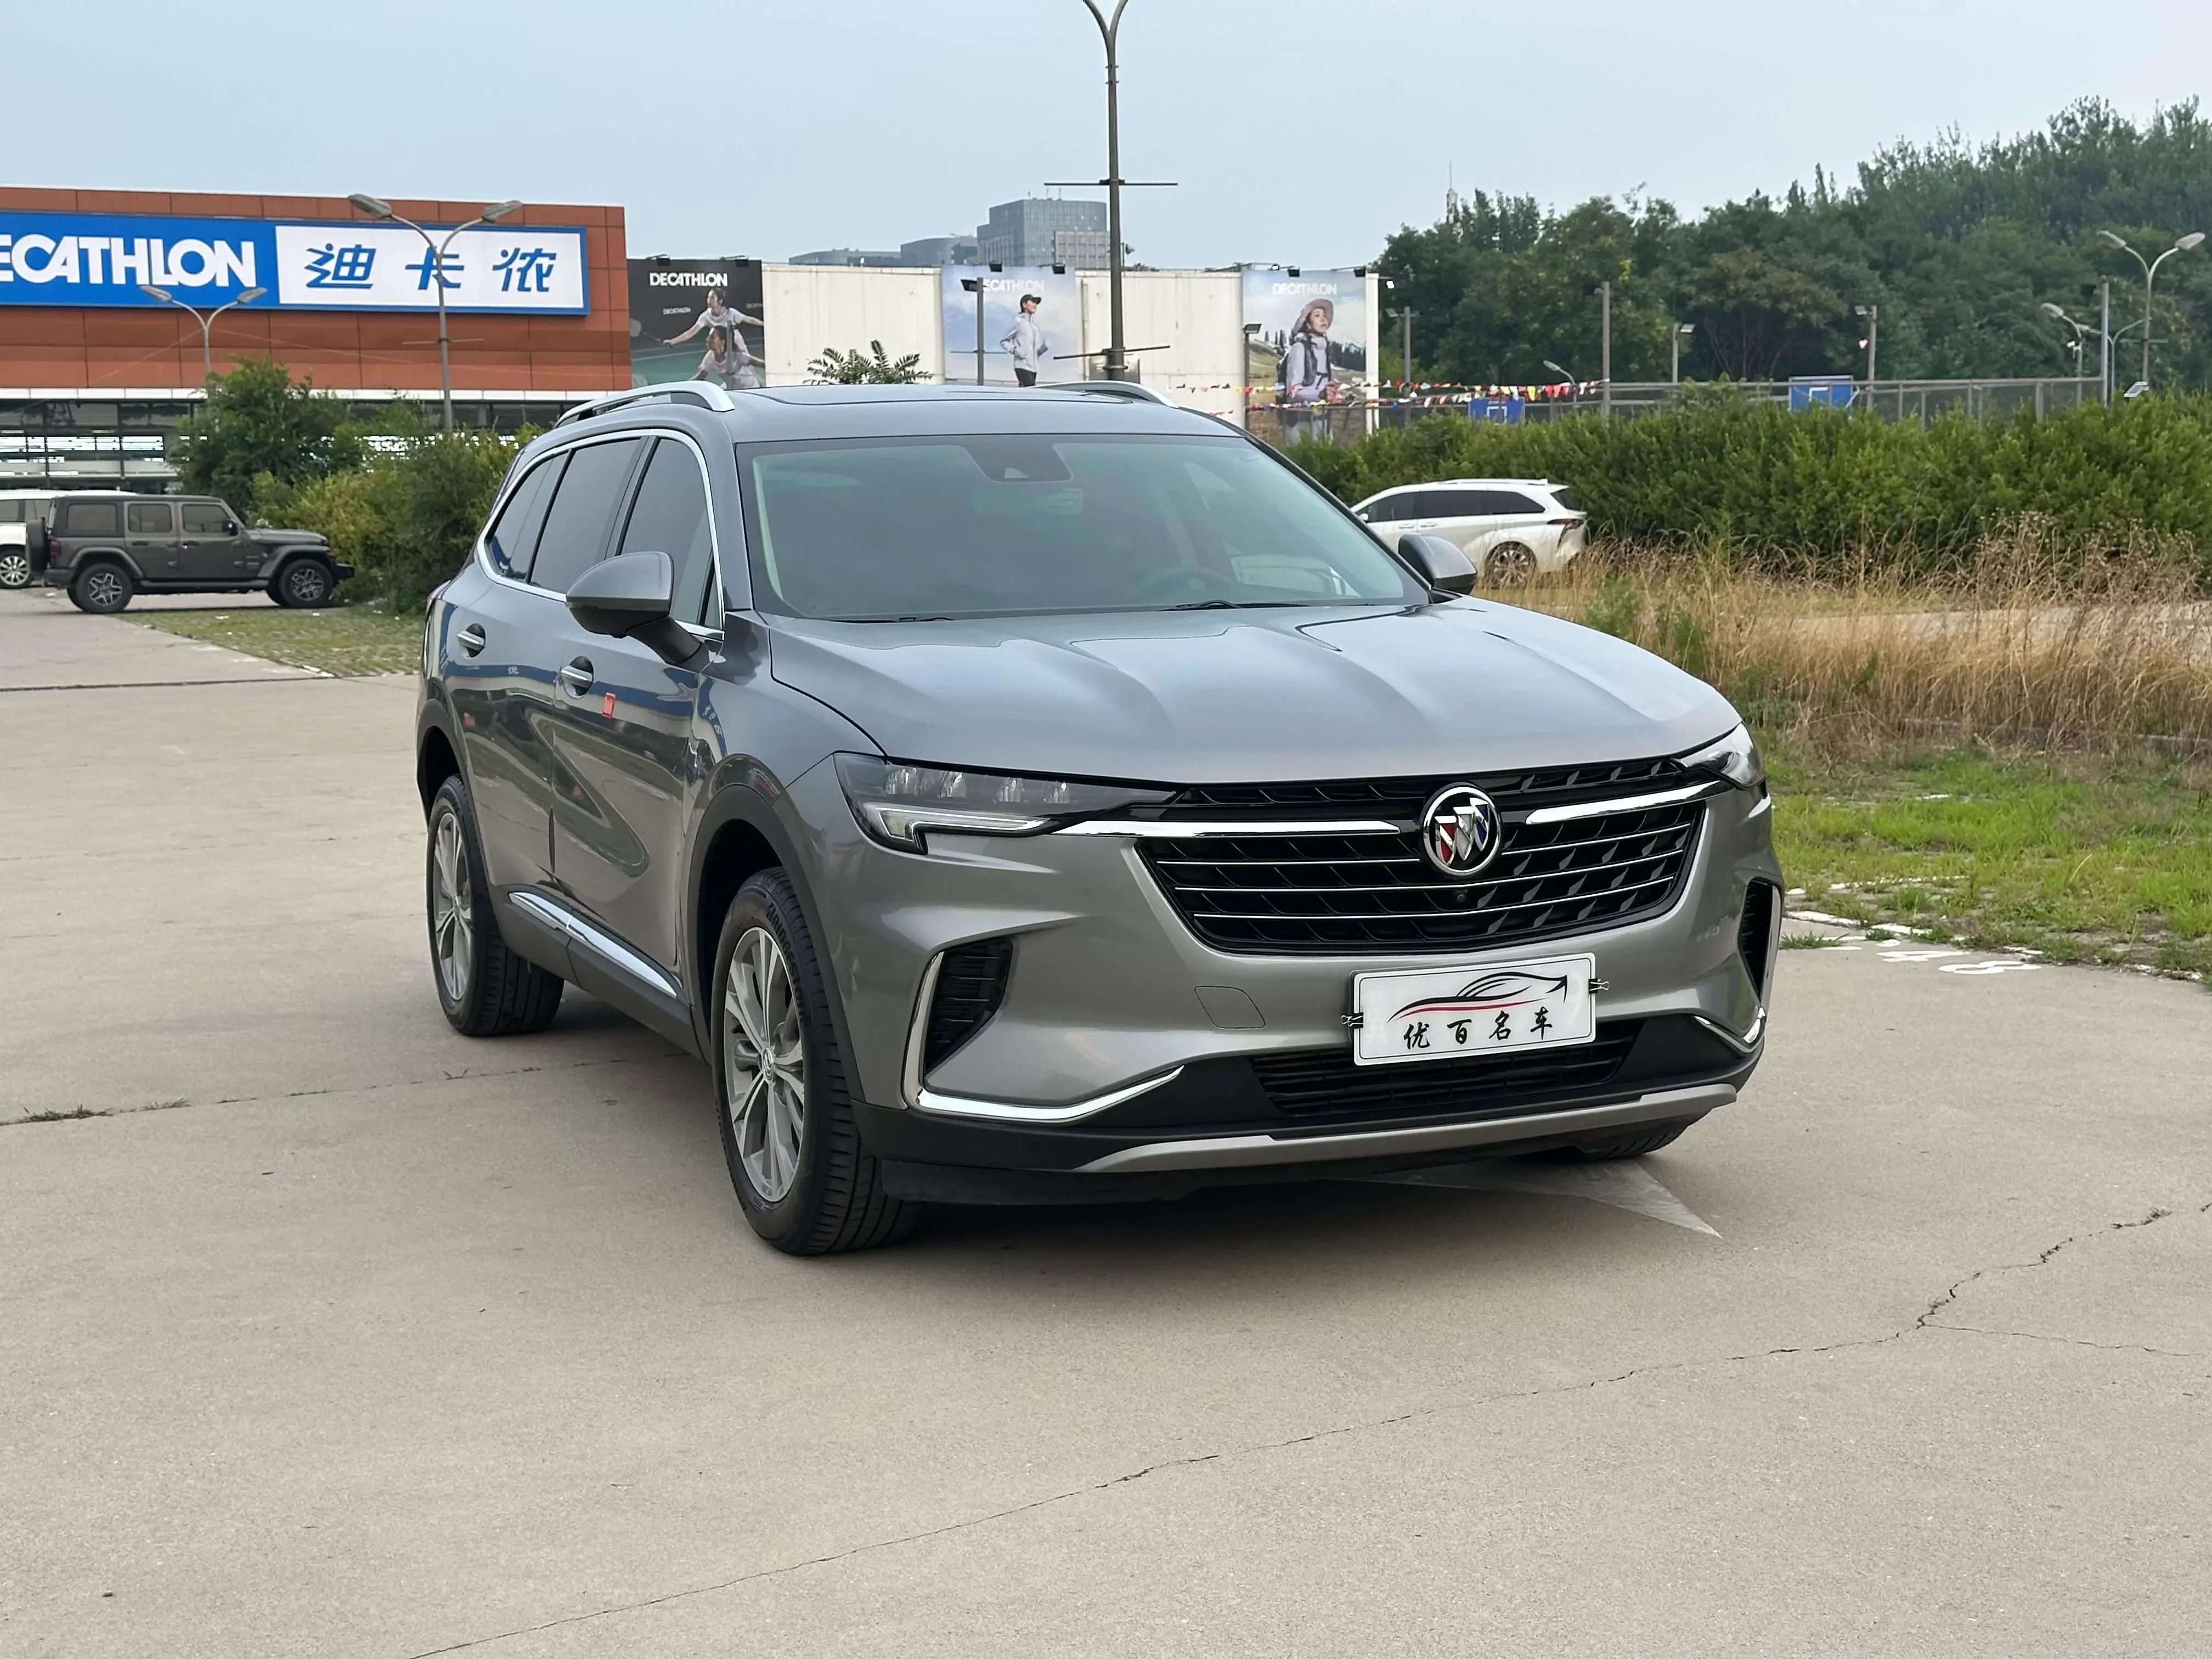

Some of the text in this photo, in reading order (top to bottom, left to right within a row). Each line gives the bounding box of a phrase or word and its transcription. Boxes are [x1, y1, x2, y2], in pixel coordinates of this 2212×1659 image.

[304, 242, 556, 292] 迪卡侬
[650, 272, 727, 286] DECATHLON
[984, 279, 1045, 291] ECATHLON
[1272, 283, 1337, 295] DECATHLON
[1403, 1006, 1553, 1049] 优百名车
